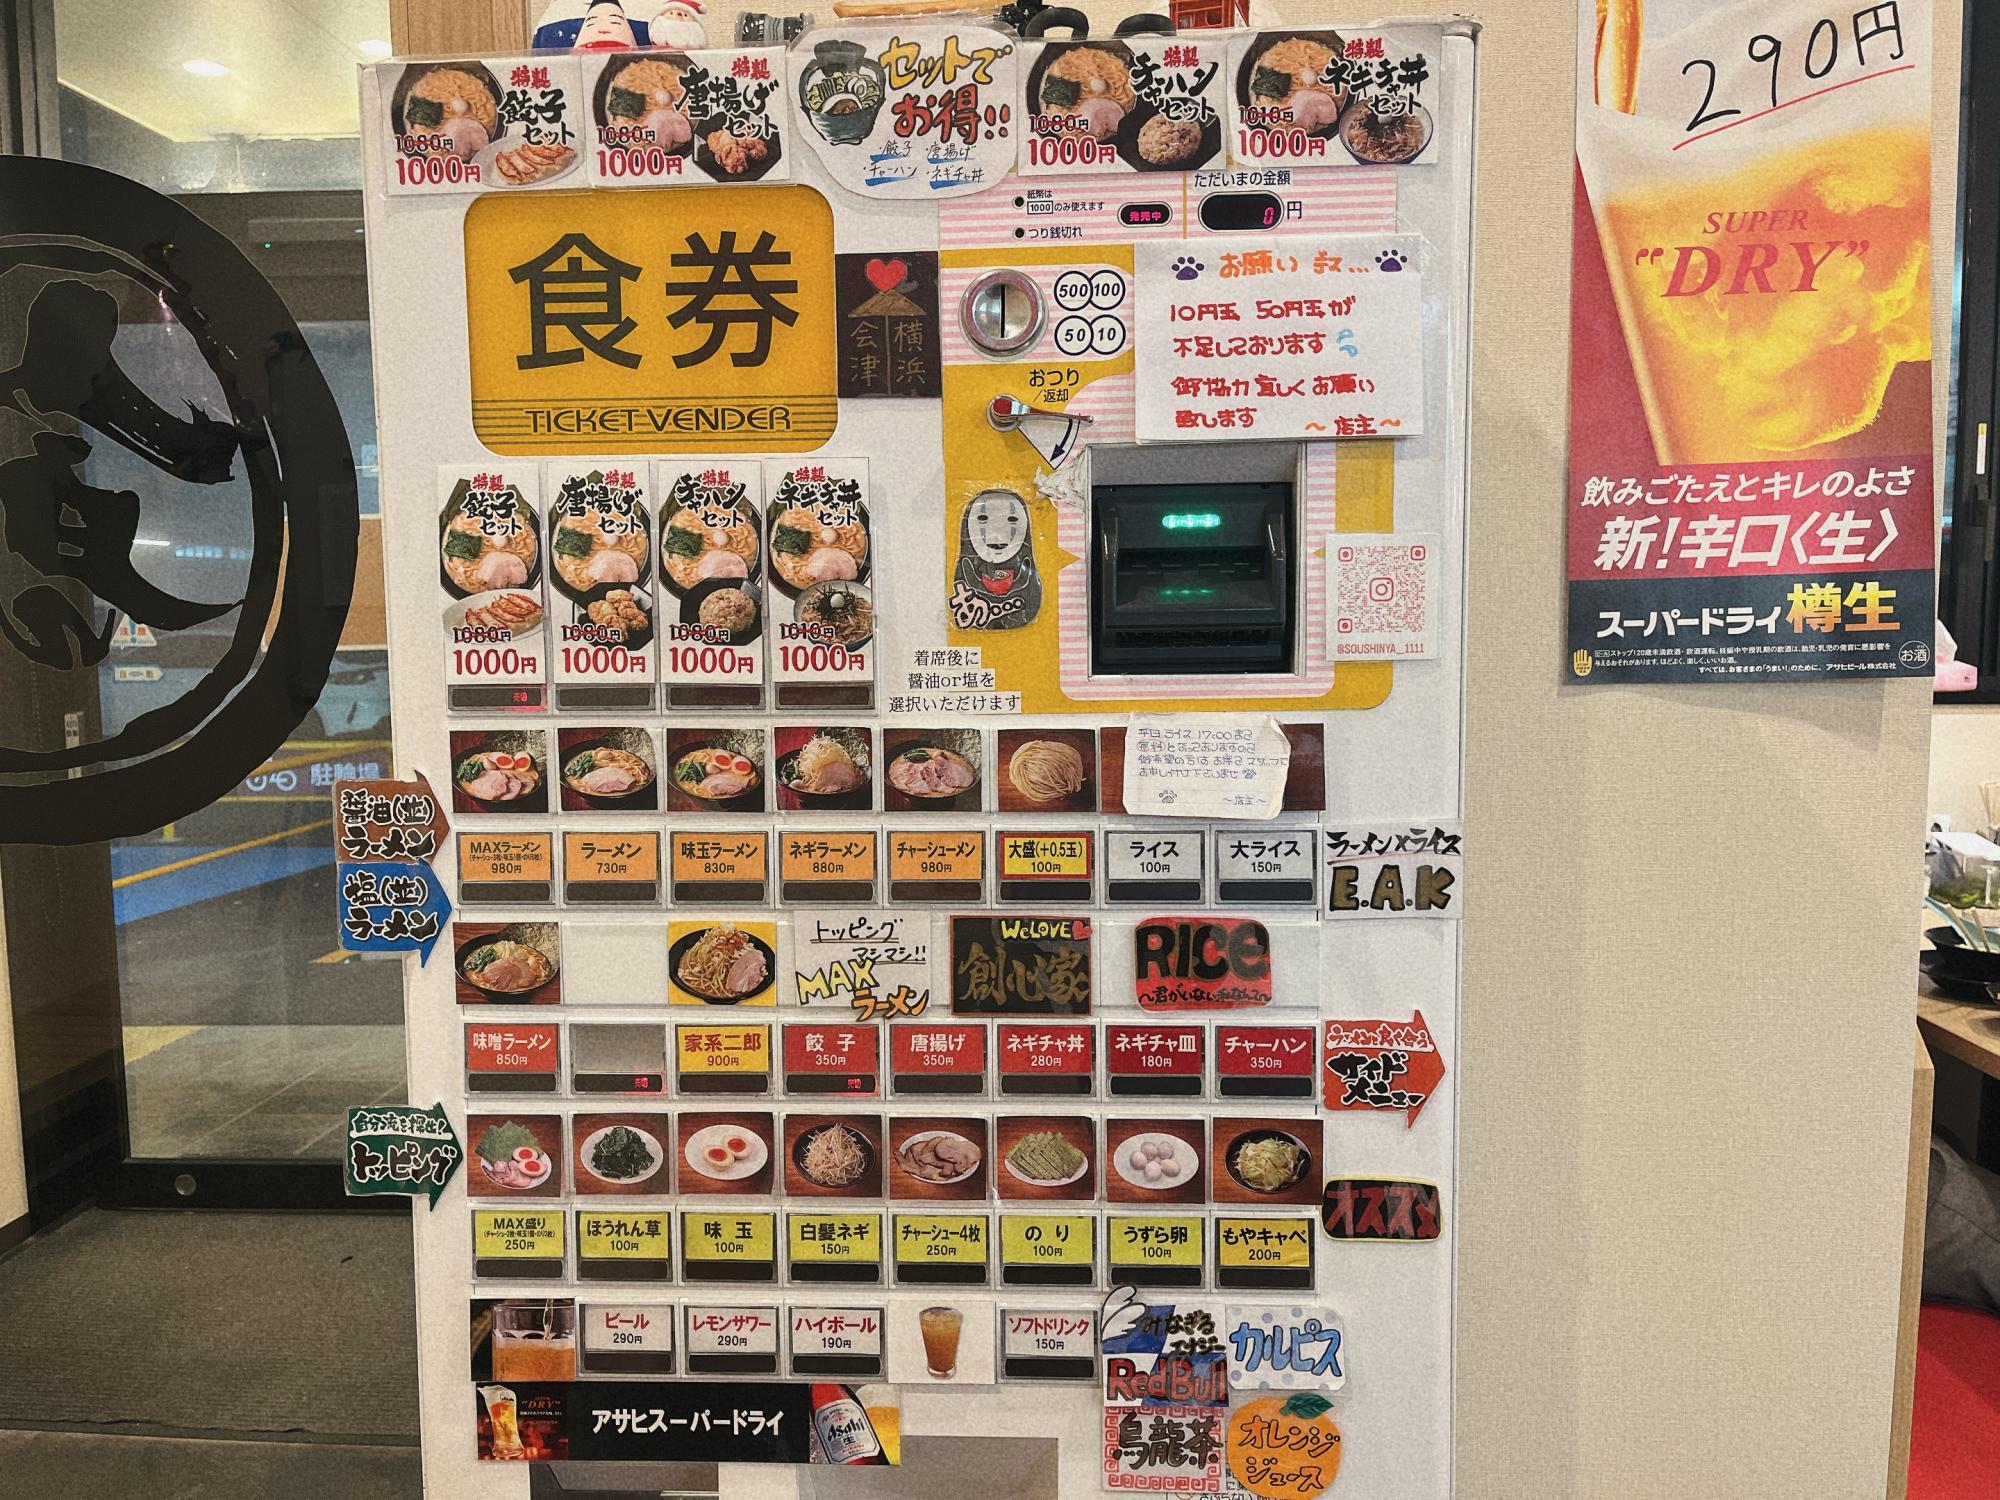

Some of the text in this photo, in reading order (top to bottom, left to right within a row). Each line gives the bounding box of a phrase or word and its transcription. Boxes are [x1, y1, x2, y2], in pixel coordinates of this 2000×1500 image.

[1164, 45, 1199, 68] 特製
[1344, 38, 1384, 59] 特製
[731, 55, 771, 80] 特製
[880, 35, 1012, 91] セットで
[1683, 1, 1904, 131] 290円
[511, 66, 550, 89] 特製
[1129, 52, 1220, 104] チャーハン
[1318, 53, 1429, 96] ネギチャ丼
[674, 67, 779, 119] 唐揚げ
[499, 88, 566, 124] 餃子
[1161, 97, 1216, 122] セット
[1371, 94, 1422, 117] セット
[725, 113, 779, 139] セット
[1029, 114, 1088, 133] 1080円
[523, 122, 576, 147] セット
[1238, 129, 1325, 158] 1000円
[1028, 136, 1115, 165] 1000円
[398, 156, 481, 185] 1000円
[597, 148, 682, 177] 1000円
[1194, 171, 1291, 187] ただいまの金額
[1027, 189, 1052, 199] 紙幣は
[1054, 201, 1104, 211] のみ使えます
[1287, 201, 1302, 219] 円
[1129, 211, 1161, 222] 発売中
[1703, 210, 1809, 234] SUPER
[1028, 226, 1082, 239] つり銭切れ
[1220, 249, 1298, 278] お願い
[1059, 283, 1120, 297] 500 100
[507, 230, 799, 370] 食券
[1170, 302, 1240, 322] 10円玉
[1065, 328, 1116, 341] 50 10
[849, 321, 880, 386] 会津
[893, 321, 927, 385] 横浜
[1174, 332, 1326, 358] 不足しております
[1029, 368, 1079, 387] おつり
[1312, 374, 1374, 395] お願い
[525, 407, 792, 433] TICKET VENDER
[473, 473, 504, 491] 特製
[605, 470, 635, 488] 特製
[702, 469, 731, 486] 特製
[795, 467, 826, 483] 特製
[675, 474, 746, 513] チャーハン
[776, 479, 862, 512] ネギチャ丼
[1581, 465, 1916, 508] 飲みごたえとキレのよさ
[462, 491, 517, 519] 餃子
[557, 477, 642, 516] 唐揚げ
[599, 516, 642, 534] セット
[702, 511, 743, 528] セット
[818, 509, 857, 526] セット
[480, 520, 522, 535] セット
[1597, 582, 1900, 638] スーパードライ 樽生
[562, 625, 620, 642] 1080円
[1337, 643, 1424, 654] @SOUSHINYA_1111
[1901, 649, 1927, 662] お酒
[453, 649, 536, 675] 1000円
[561, 647, 646, 674] 1000円
[669, 647, 753, 673] 1000円
[780, 646, 864, 671] 1000円
[914, 650, 980, 666] 着席後に
[908, 672, 994, 689] 醤油or塩を
[889, 695, 1020, 713] 選択いただけます
[1138, 729, 1232, 739] 平日 ライス 17:00
[311, 762, 380, 786] 駐輪場
[342, 826, 435, 859] ラーメン
[470, 841, 541, 853] MAXラーメン
[581, 842, 641, 858] ラーメン
[682, 842, 757, 859] 味玉ラーメン
[789, 842, 867, 859] ネギラーメン
[897, 840, 976, 858] チャーシューメン
[1130, 842, 1180, 858] ライス
[1231, 841, 1301, 858] 大ライス
[491, 863, 522, 873] 980円
[597, 861, 626, 874] 730円
[704, 862, 735, 874] 830円
[813, 862, 844, 874] 880円
[921, 861, 952, 873] 980円
[1031, 861, 1061, 874] 100円
[1140, 861, 1170, 873] 100円
[1251, 861, 1281, 873] 150円
[345, 907, 438, 941] ラーメン
[817, 918, 903, 941] トッピング
[795, 959, 879, 1005] MAX
[852, 986, 929, 1022] ラーメン
[473, 1033, 551, 1050] 味噌ラーメン
[684, 1033, 761, 1052] 家系二郎
[805, 1033, 856, 1052] 餃子
[910, 1033, 965, 1053] 唐揚げ
[1007, 1034, 1085, 1053] ネギチャ丼
[1115, 1034, 1197, 1053] ネギチャ皿
[1225, 1037, 1307, 1053] チャーハン
[496, 1054, 527, 1065] 850円
[707, 1055, 739, 1066] 900円
[815, 1054, 846, 1065] 350円
[923, 1055, 953, 1066] 350円
[1031, 1055, 1061, 1067] 280円
[1141, 1055, 1172, 1067] 180円
[1251, 1057, 1282, 1068] 350円
[1326, 1052, 1407, 1081] サイド
[1342, 1076, 1425, 1107] メニュー
[351, 1141, 456, 1184] トッピング
[1326, 1181, 1440, 1237] オススメ
[494, 1218, 546, 1229] MAX盛り
[587, 1221, 660, 1238] ほうれん草
[704, 1222, 753, 1239] 味玉
[800, 1223, 869, 1241] 白髪ネギ
[902, 1224, 981, 1243] チャーシュー4枚
[1025, 1224, 1069, 1242] のり
[1123, 1225, 1188, 1245] うずら卵
[1222, 1228, 1307, 1246] もやキャベ
[505, 1239, 535, 1250] 250円
[611, 1241, 638, 1251] 100円
[715, 1242, 744, 1253] 100円
[820, 1244, 849, 1254] 150円
[927, 1245, 956, 1256] 250円
[1033, 1245, 1063, 1257] 100円
[1142, 1247, 1171, 1258] 100円
[1248, 1249, 1281, 1261] 200円
[605, 1313, 648, 1329] ビール
[693, 1314, 771, 1332] レモンサワー
[796, 1316, 876, 1334] ハイボール
[1009, 1317, 1088, 1336] ソフトドリンク
[613, 1333, 642, 1345] 290円
[718, 1335, 747, 1346] 290円
[822, 1337, 851, 1349] 190円
[1035, 1338, 1064, 1350] 150円
[1170, 1336, 1226, 1355] エナジー
[1230, 1318, 1342, 1376] カルピス
[592, 1409, 784, 1435] アサヒスーパードライ
[827, 1418, 865, 1441] Asahi
[1113, 1412, 1224, 1469] 烏龍茶
[1239, 1415, 1341, 1458] オレンジ
[1247, 1456, 1324, 1492] ジュース
